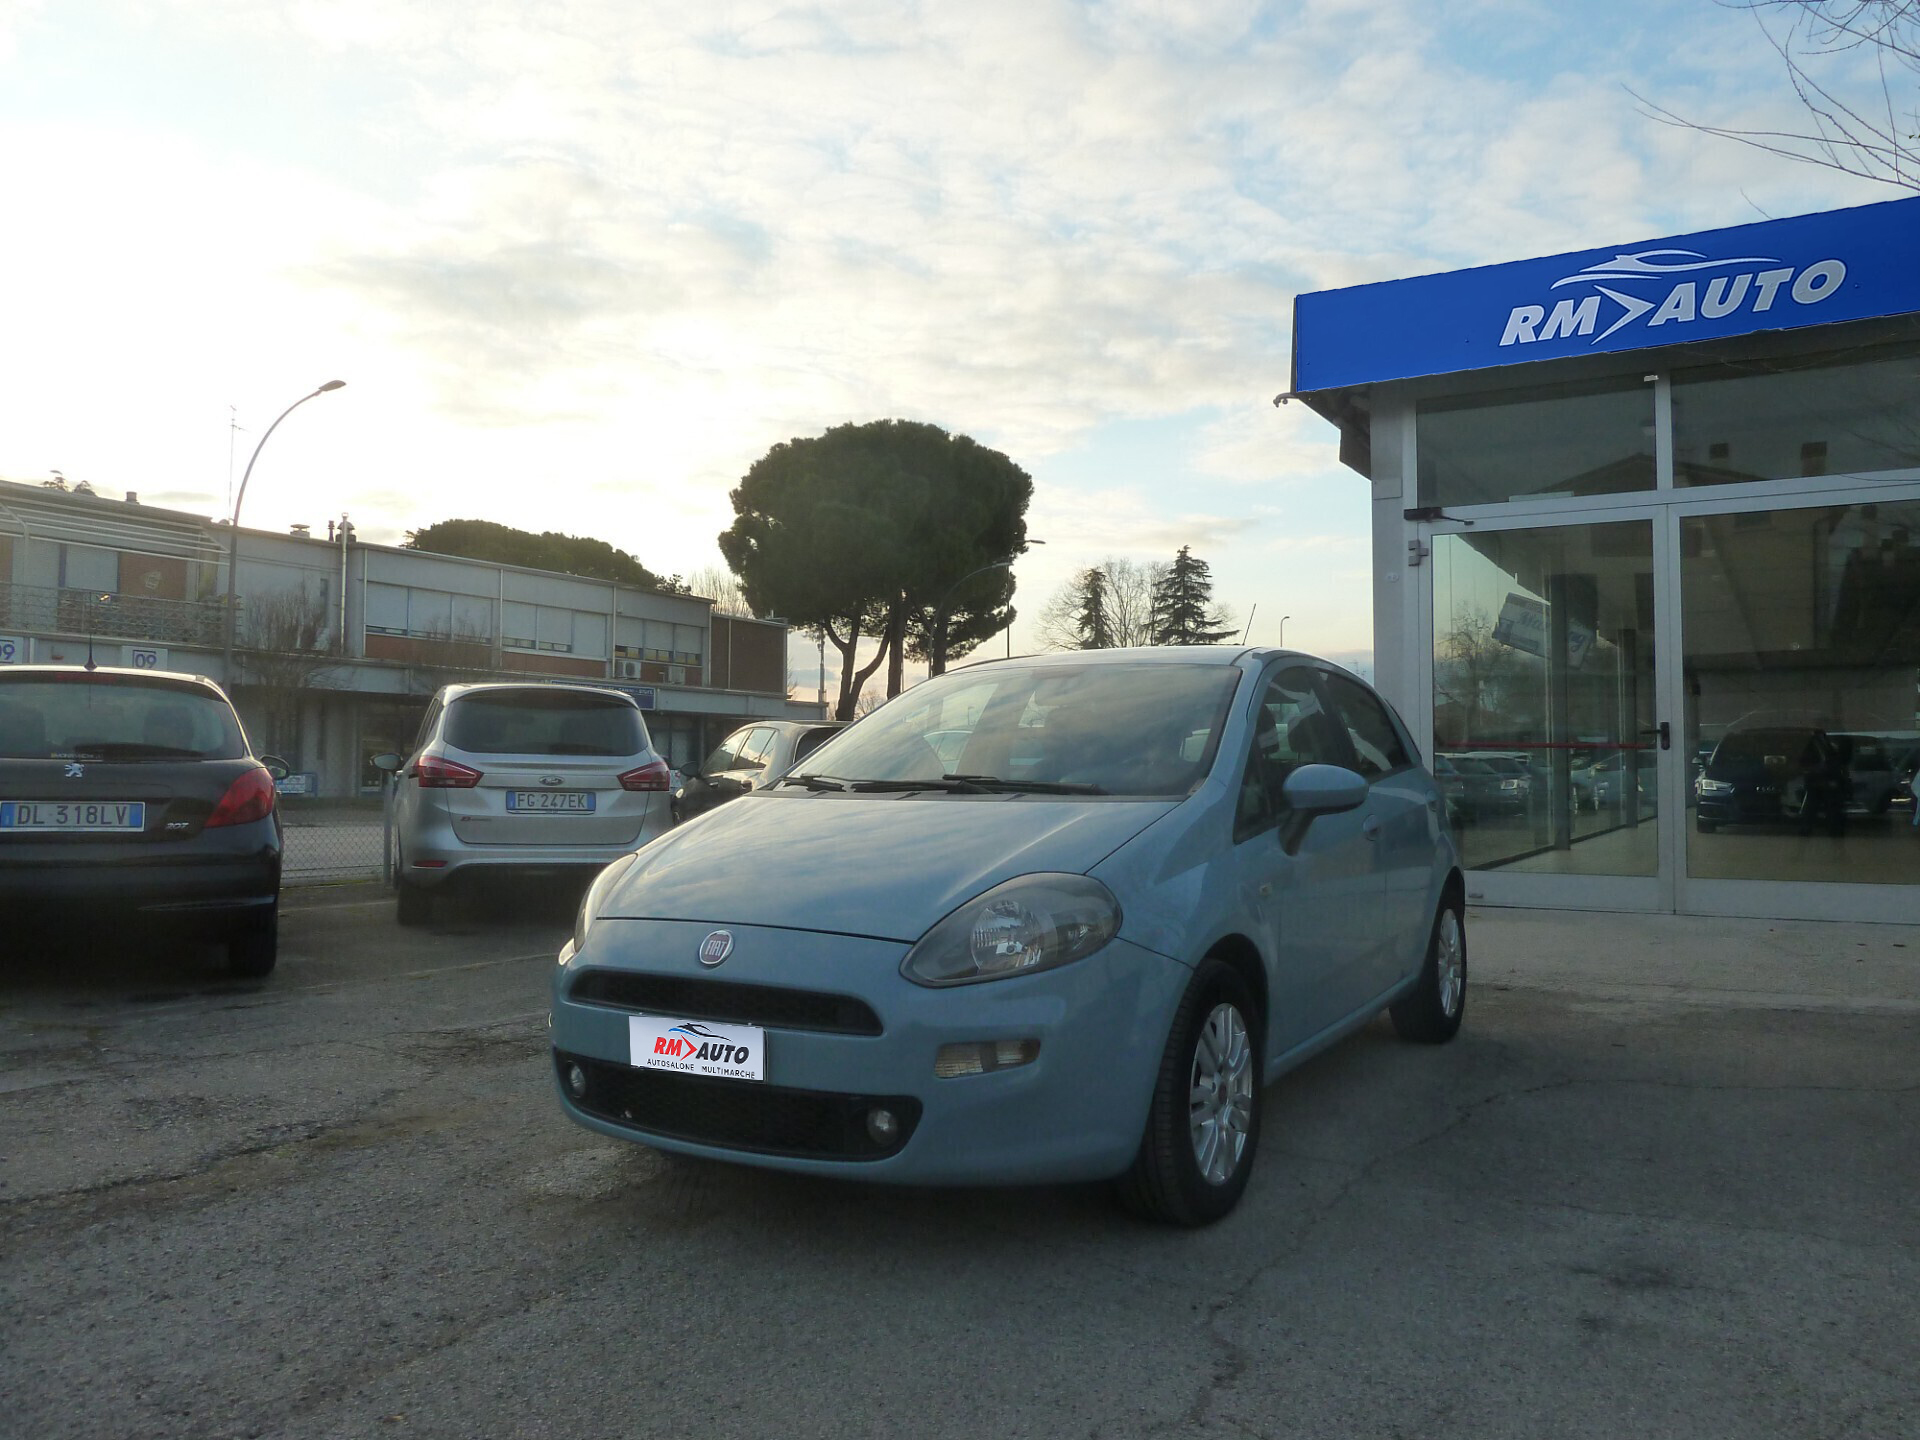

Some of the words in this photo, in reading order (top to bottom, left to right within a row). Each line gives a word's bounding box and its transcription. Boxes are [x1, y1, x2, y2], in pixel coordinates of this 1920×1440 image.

[1647, 259, 1847, 326] AUTO
[0, 643, 15, 660] 9
[134, 653, 157, 668] 09
[517, 793, 535, 808] FG
[540, 793, 586, 808] 247EK
[17, 805, 45, 825] DL
[56, 805, 127, 825] 318LV
[705, 940, 726, 956] FIAT
[653, 1036, 683, 1057] RM
[694, 1042, 750, 1065] AUTO
[646, 1058, 695, 1072] AUTOSALONE
[701, 1065, 756, 1080] MULTIMARCHE
